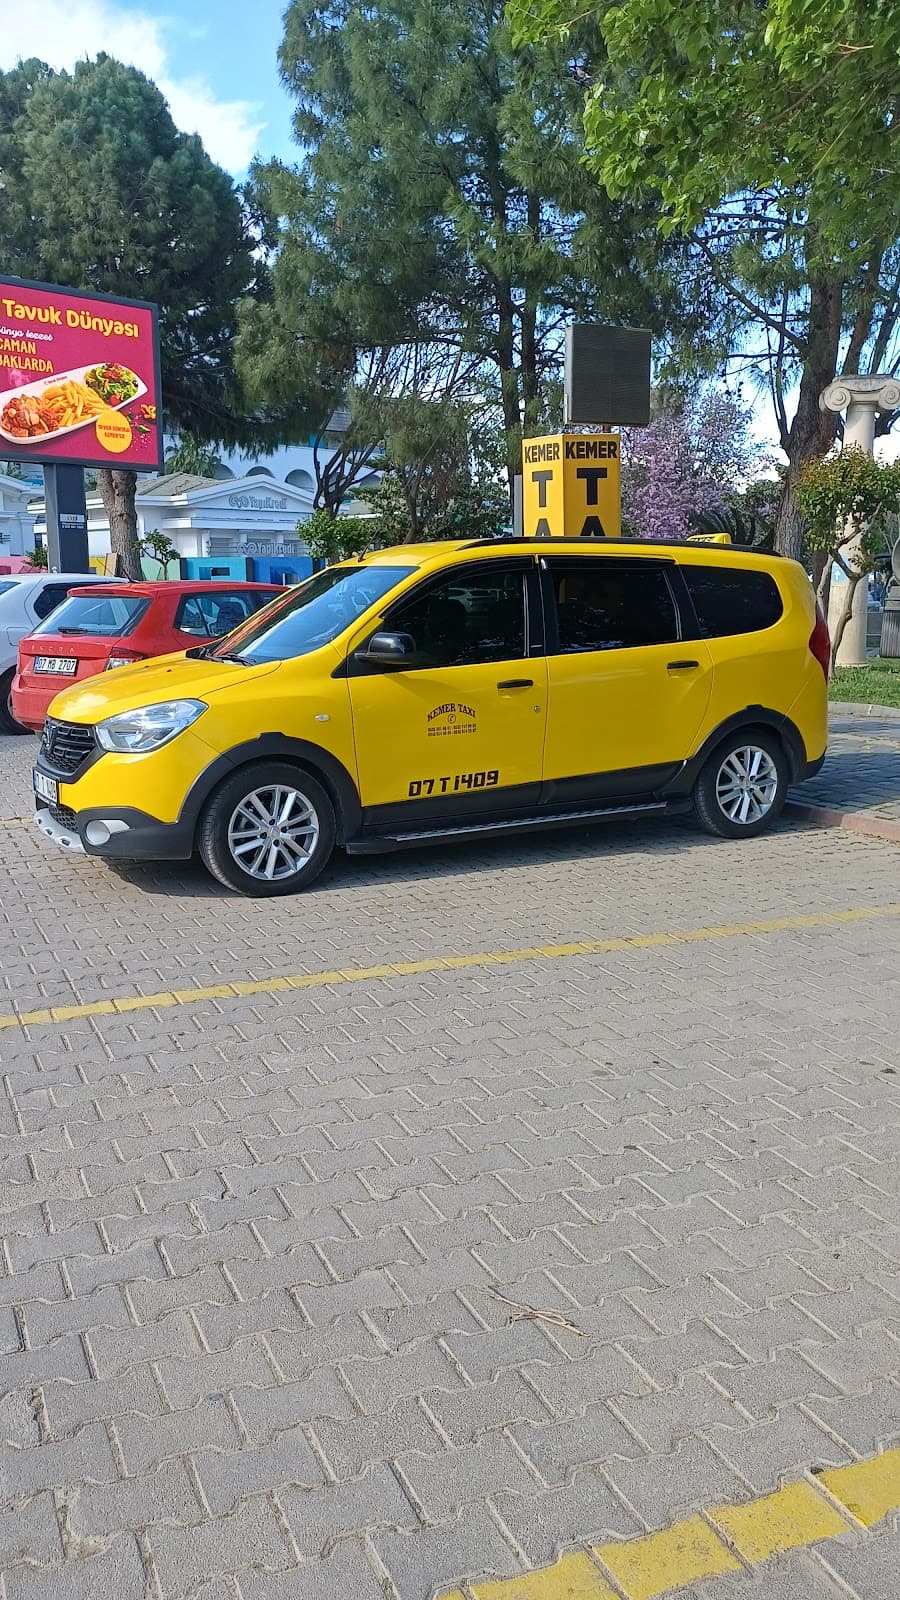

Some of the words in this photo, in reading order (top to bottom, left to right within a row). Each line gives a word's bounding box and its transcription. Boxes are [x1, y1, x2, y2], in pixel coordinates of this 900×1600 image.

[2, 299, 62, 325] Tavuk
[66, 309, 139, 338] Dünyası
[524, 443, 560, 463] KEMER
[566, 441, 618, 459] KEMER
[58, 660, 76, 671] 2707
[427, 703, 456, 722] KEMER
[457, 703, 476, 718] TAXI
[408, 779, 434, 796] 07
[440, 777, 450, 792] T
[454, 770, 499, 790] 1409
